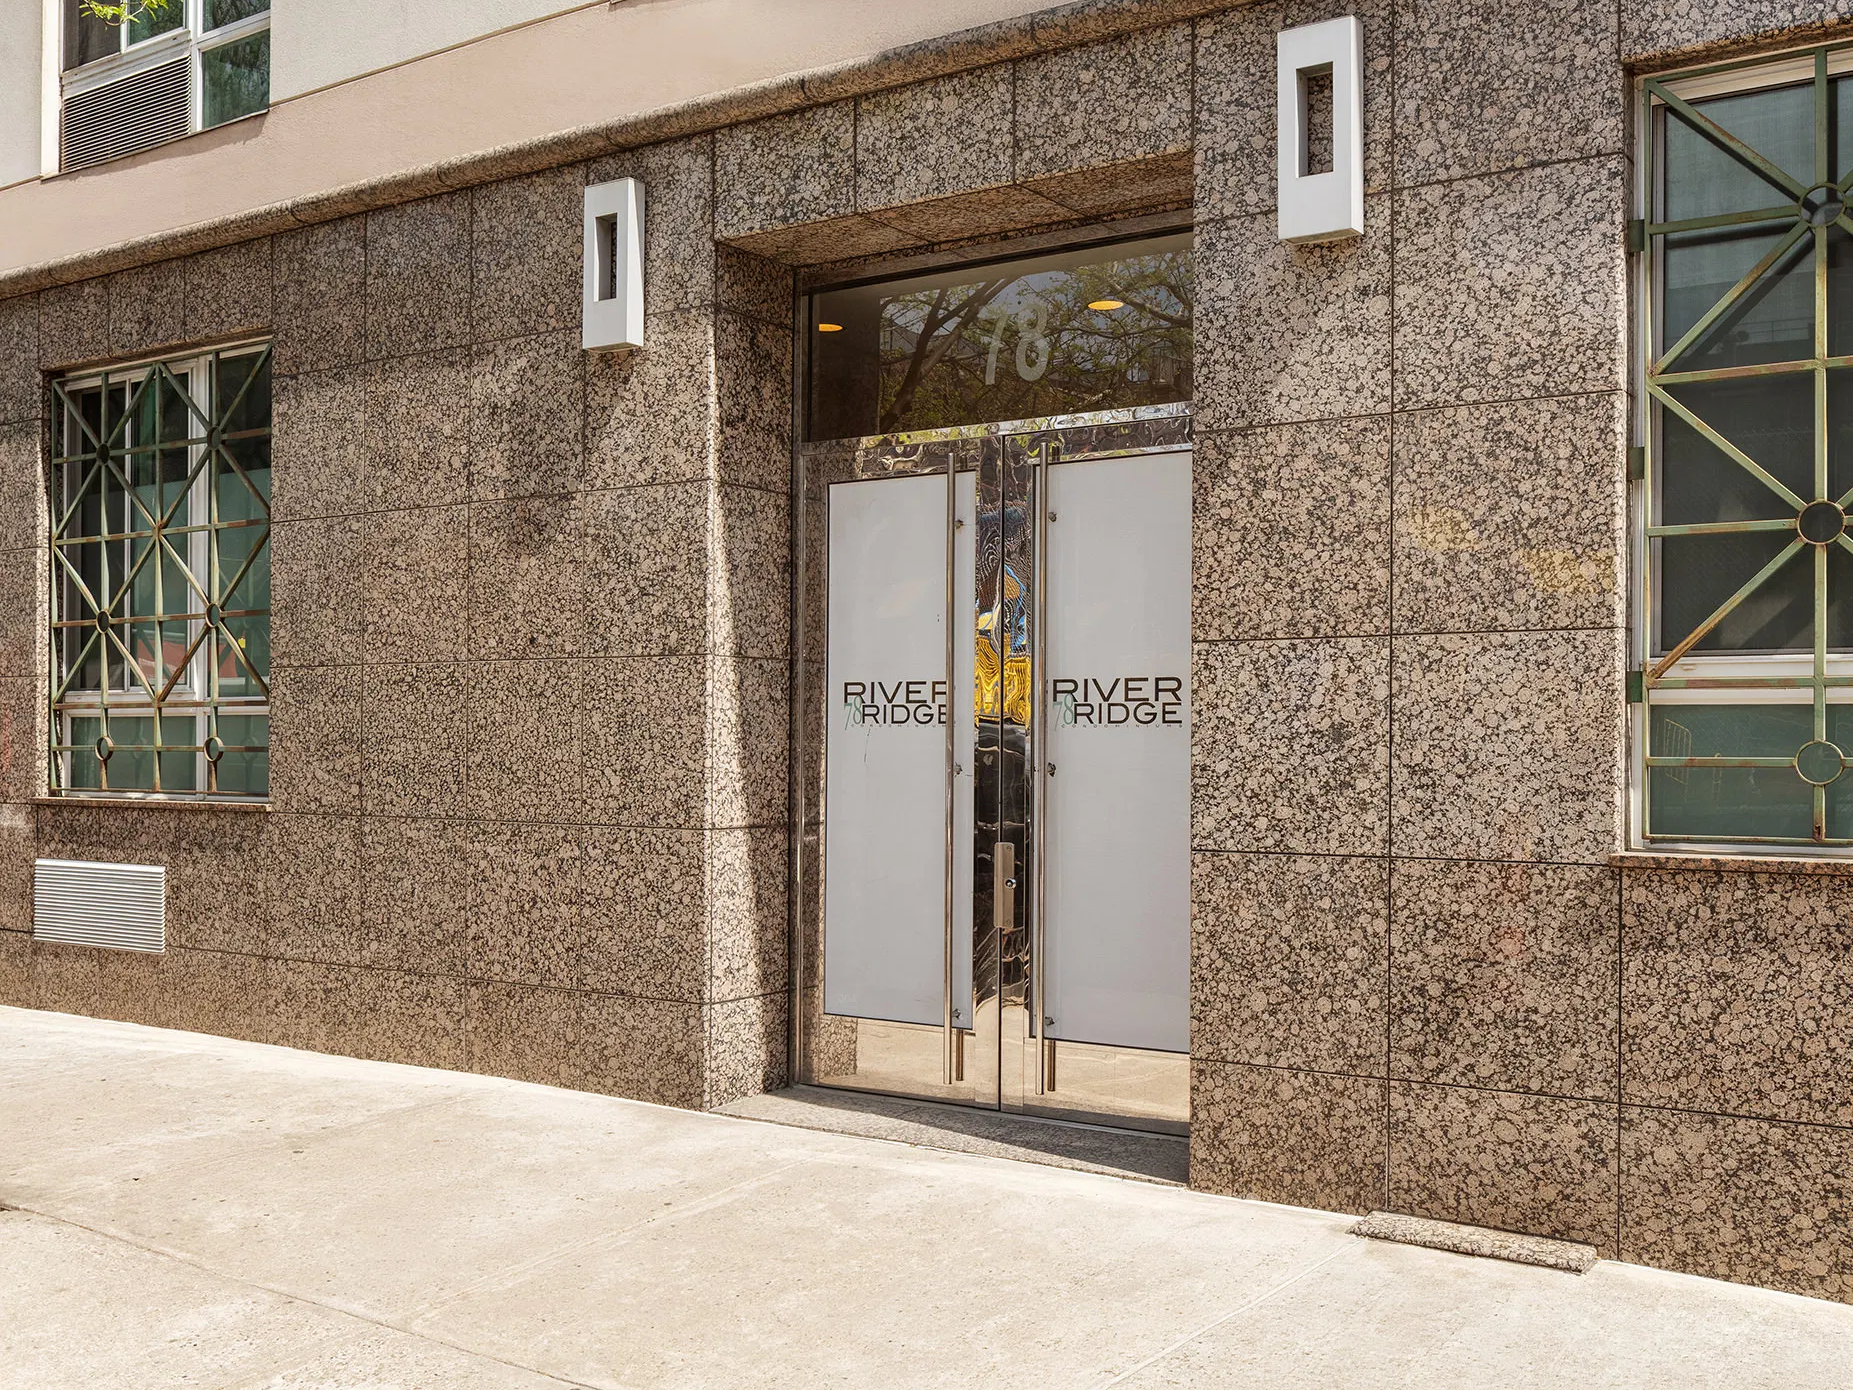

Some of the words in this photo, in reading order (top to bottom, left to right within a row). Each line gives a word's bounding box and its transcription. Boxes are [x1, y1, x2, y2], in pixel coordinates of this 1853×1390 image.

[1052, 677, 1183, 703] RIVER
[843, 695, 863, 730] 78
[1052, 692, 1074, 731] 78
[1073, 702, 1183, 724] RIDGE
